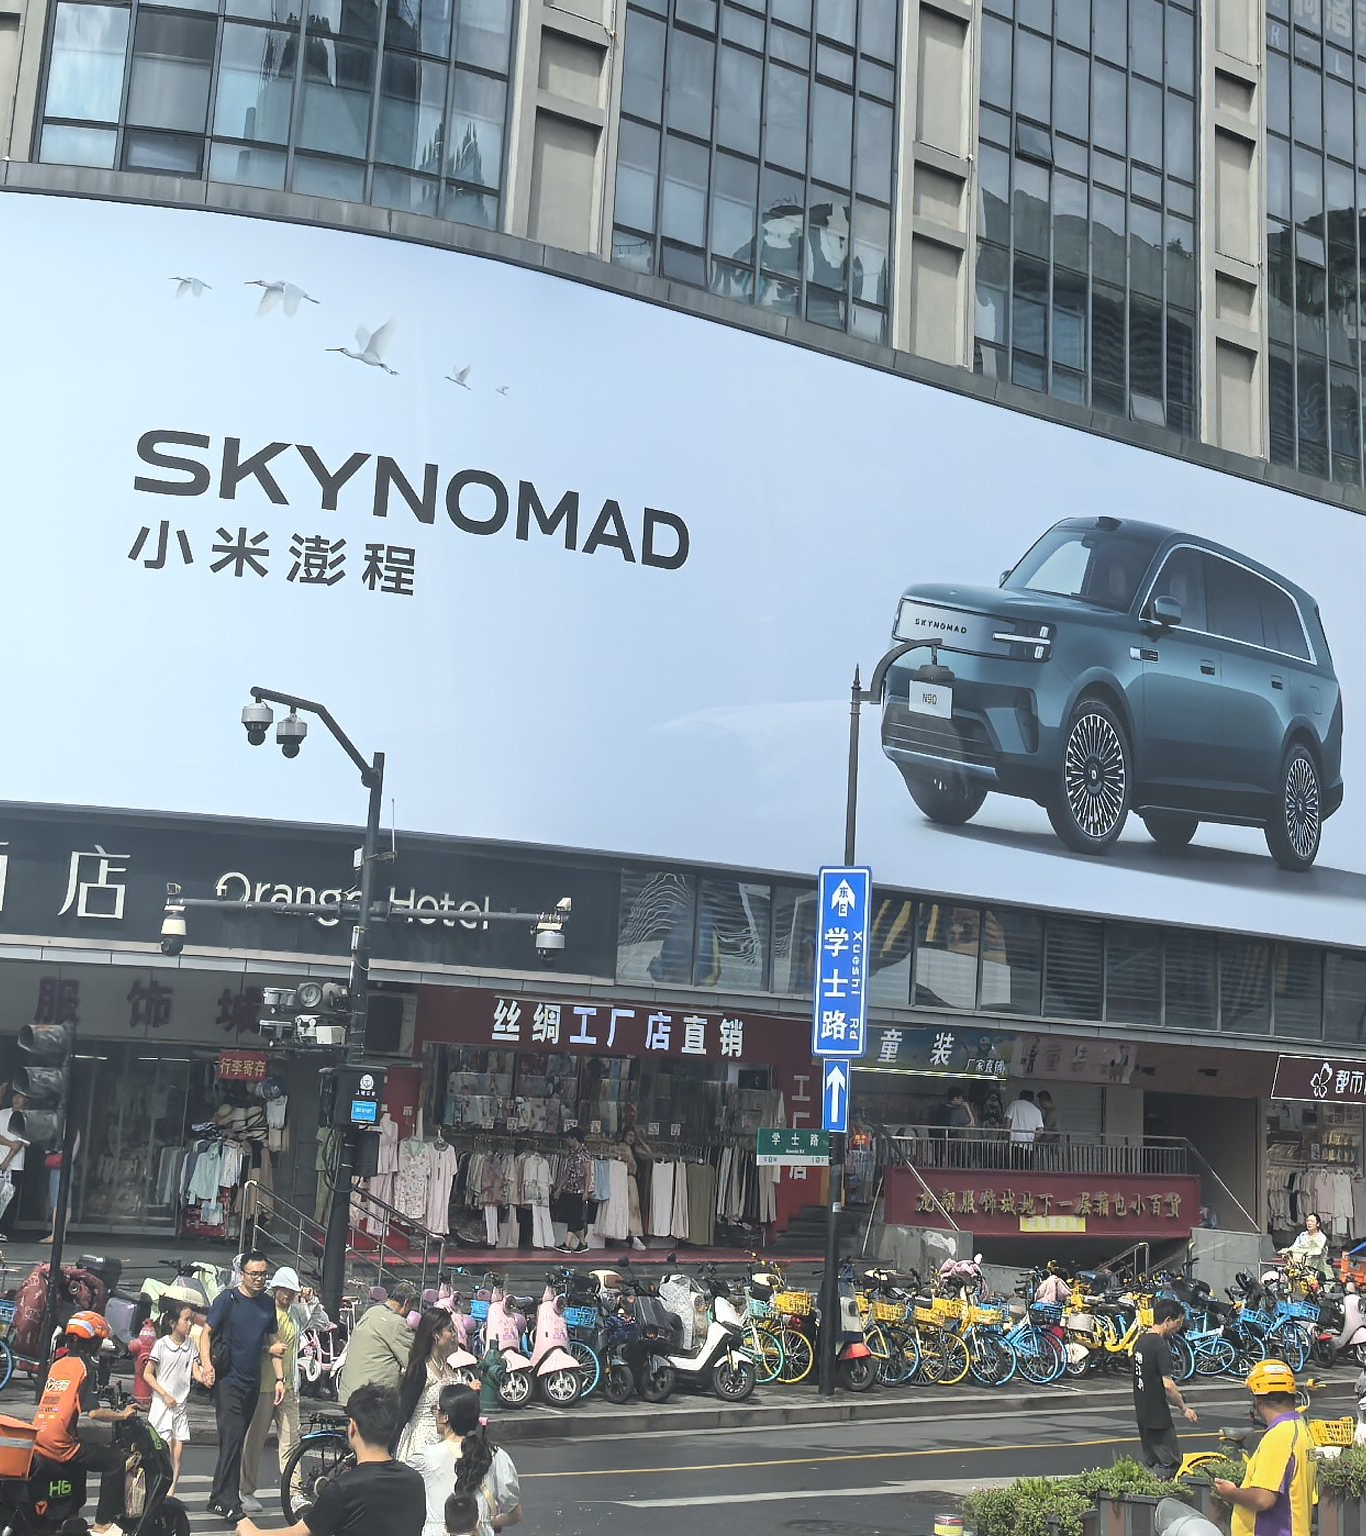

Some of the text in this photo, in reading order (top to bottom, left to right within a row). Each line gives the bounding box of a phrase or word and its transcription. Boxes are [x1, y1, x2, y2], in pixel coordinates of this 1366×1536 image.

[133, 429, 690, 570] SKYNOMAD
[128, 520, 416, 596] 小米澎程
[914, 618, 968, 634] SKYNOMAD
[389, 885, 490, 930] Hotel
[821, 927, 849, 1041] 学士路
[849, 931, 863, 1041] Xueshi Rd
[491, 998, 744, 1057] 丝绸工厂店直销
[878, 1029, 955, 1067] 童装
[219, 1057, 267, 1077] 行李寄存
[771, 1132, 819, 1147] 学士路
